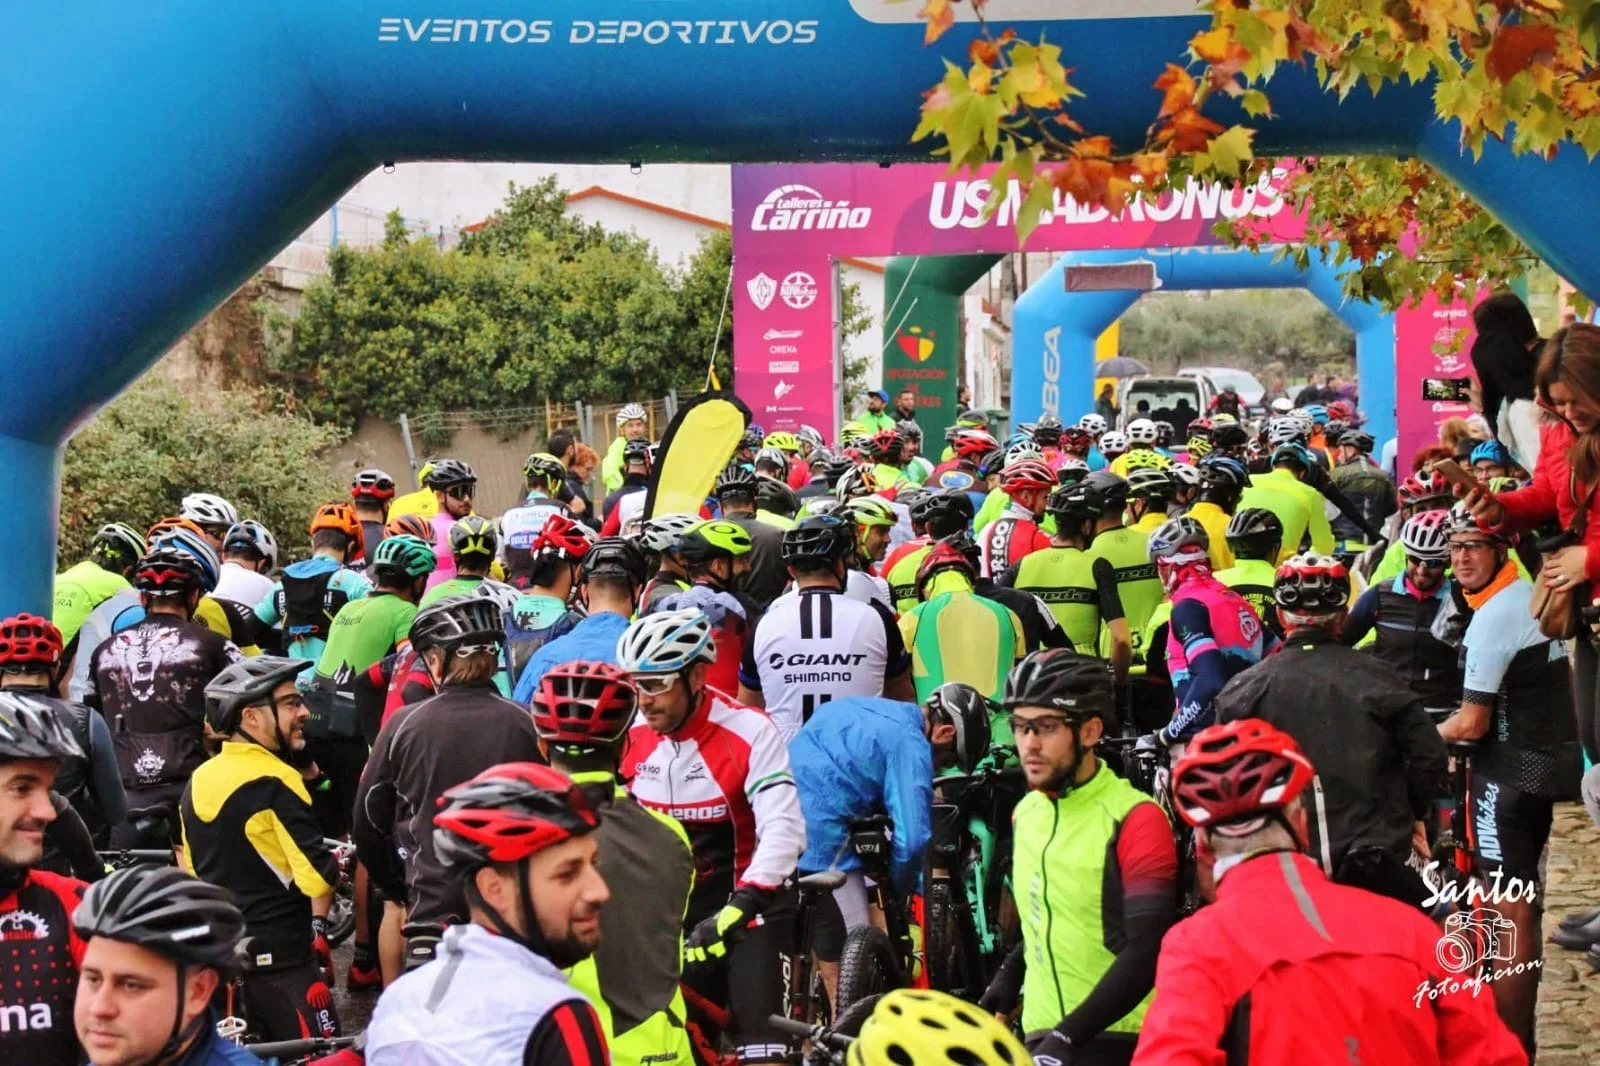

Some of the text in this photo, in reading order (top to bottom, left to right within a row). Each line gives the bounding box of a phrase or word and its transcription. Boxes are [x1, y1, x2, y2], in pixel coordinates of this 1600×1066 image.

[378, 18, 818, 44] EVENTOS DEPORTIVOS
[777, 197, 824, 209] talleres
[751, 200, 872, 231] Carriño
[787, 654, 867, 666] GIANT
[784, 672, 852, 683] SHIMANO
